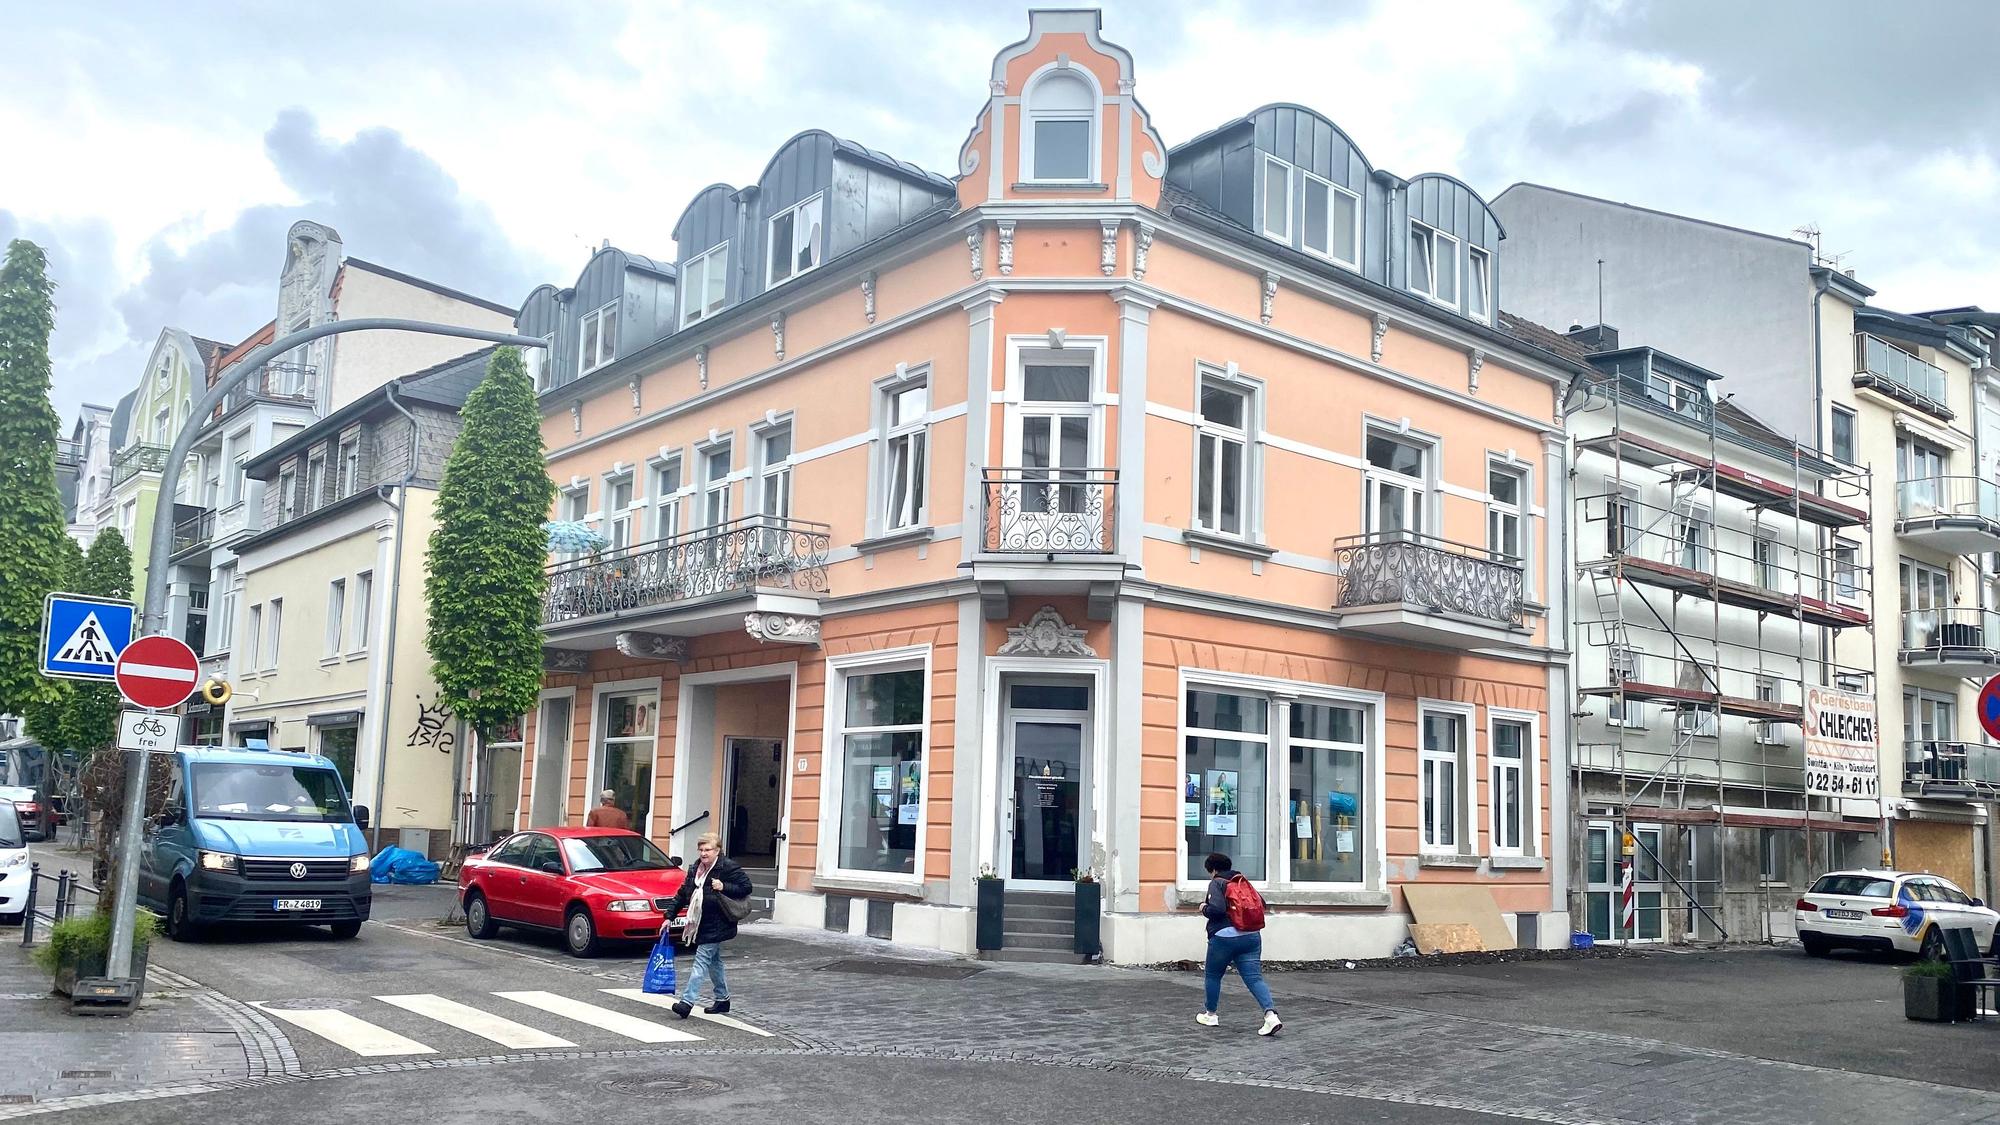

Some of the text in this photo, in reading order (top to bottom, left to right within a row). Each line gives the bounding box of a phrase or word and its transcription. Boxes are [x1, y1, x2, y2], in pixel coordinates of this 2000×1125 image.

[1806, 689, 1873, 742] SCHLEICHER
[139, 737, 157, 747] frei
[1807, 771, 1814, 789] 0
[1816, 773, 1829, 791] 22
[1831, 775, 1844, 793] 54
[1851, 777, 1862, 794] 61
[1866, 778, 1876, 795] 11
[278, 900, 290, 908] FR
